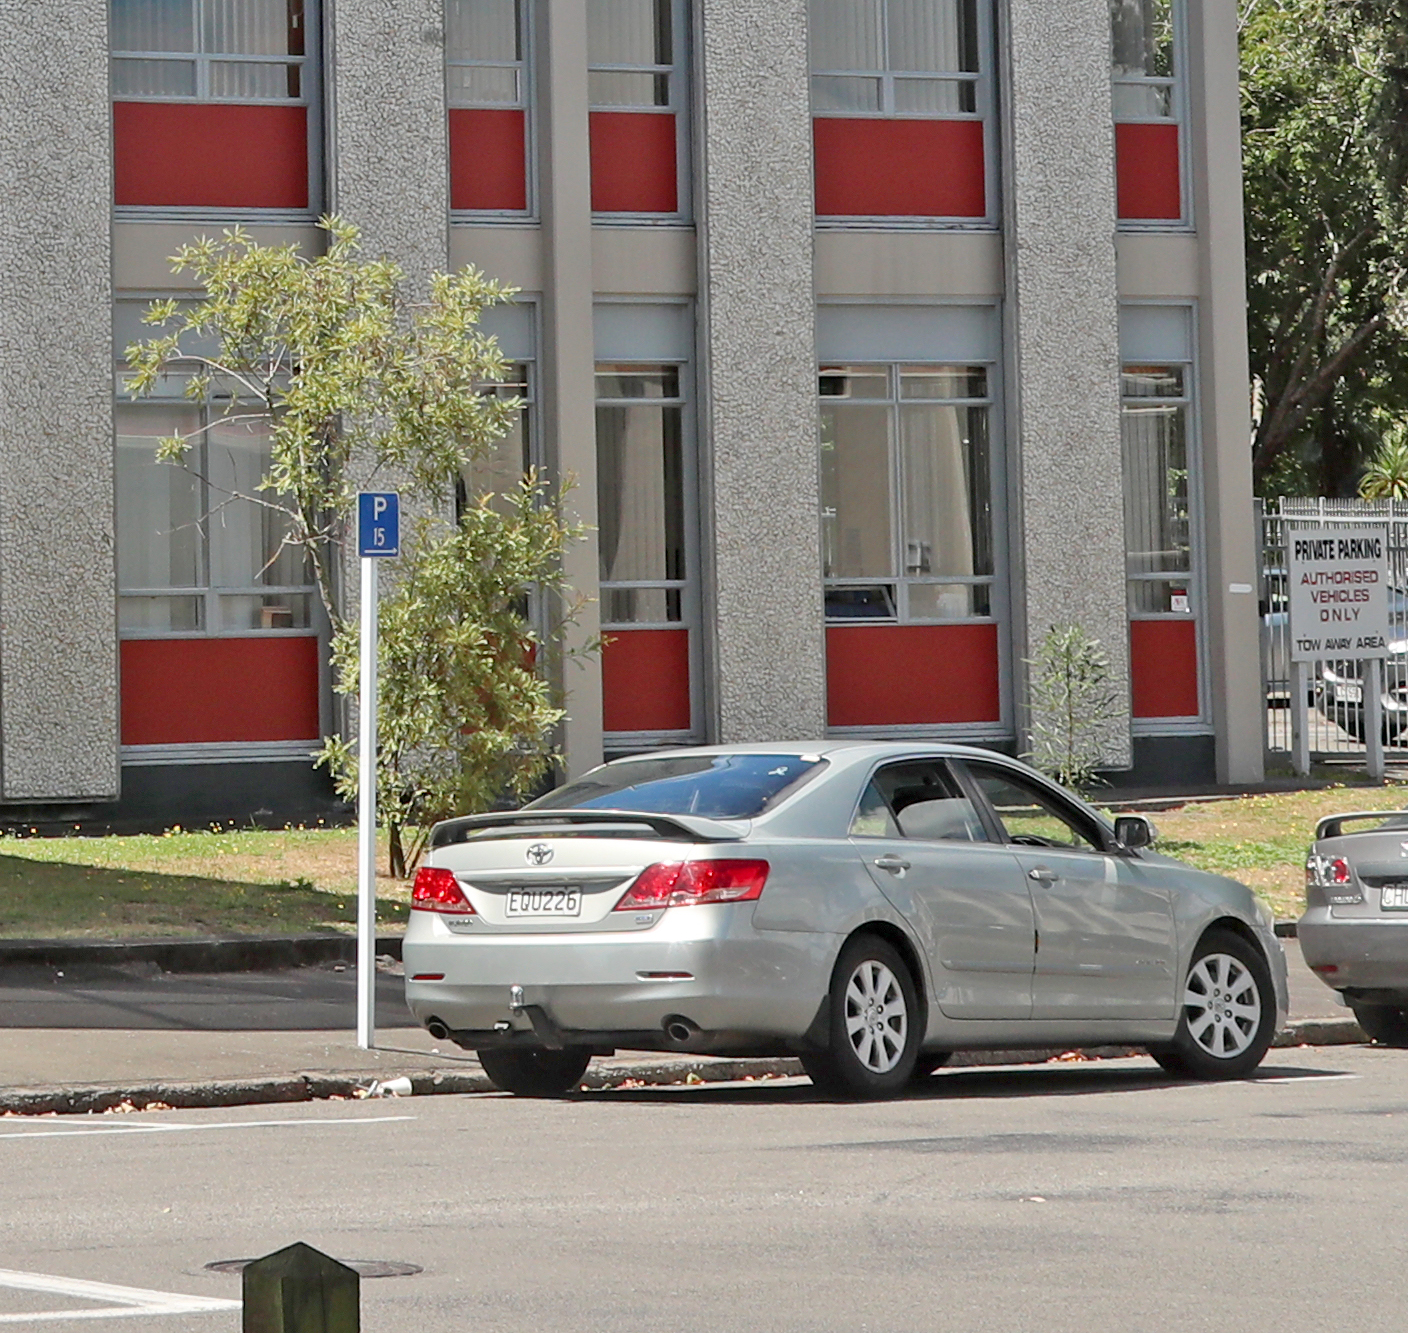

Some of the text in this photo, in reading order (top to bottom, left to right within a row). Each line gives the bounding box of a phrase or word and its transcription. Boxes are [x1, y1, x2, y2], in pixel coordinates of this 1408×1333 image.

[374, 497, 387, 521] P
[374, 528, 385, 546] 15
[1295, 538, 1382, 560] PRIVATE PARKING
[1301, 571, 1378, 585] AUTHORISED
[1310, 589, 1370, 603] VEHICLES
[1320, 607, 1361, 622] ONLY
[1296, 637, 1386, 651] TOW AWAY AREA
[509, 890, 577, 912] EQU226
